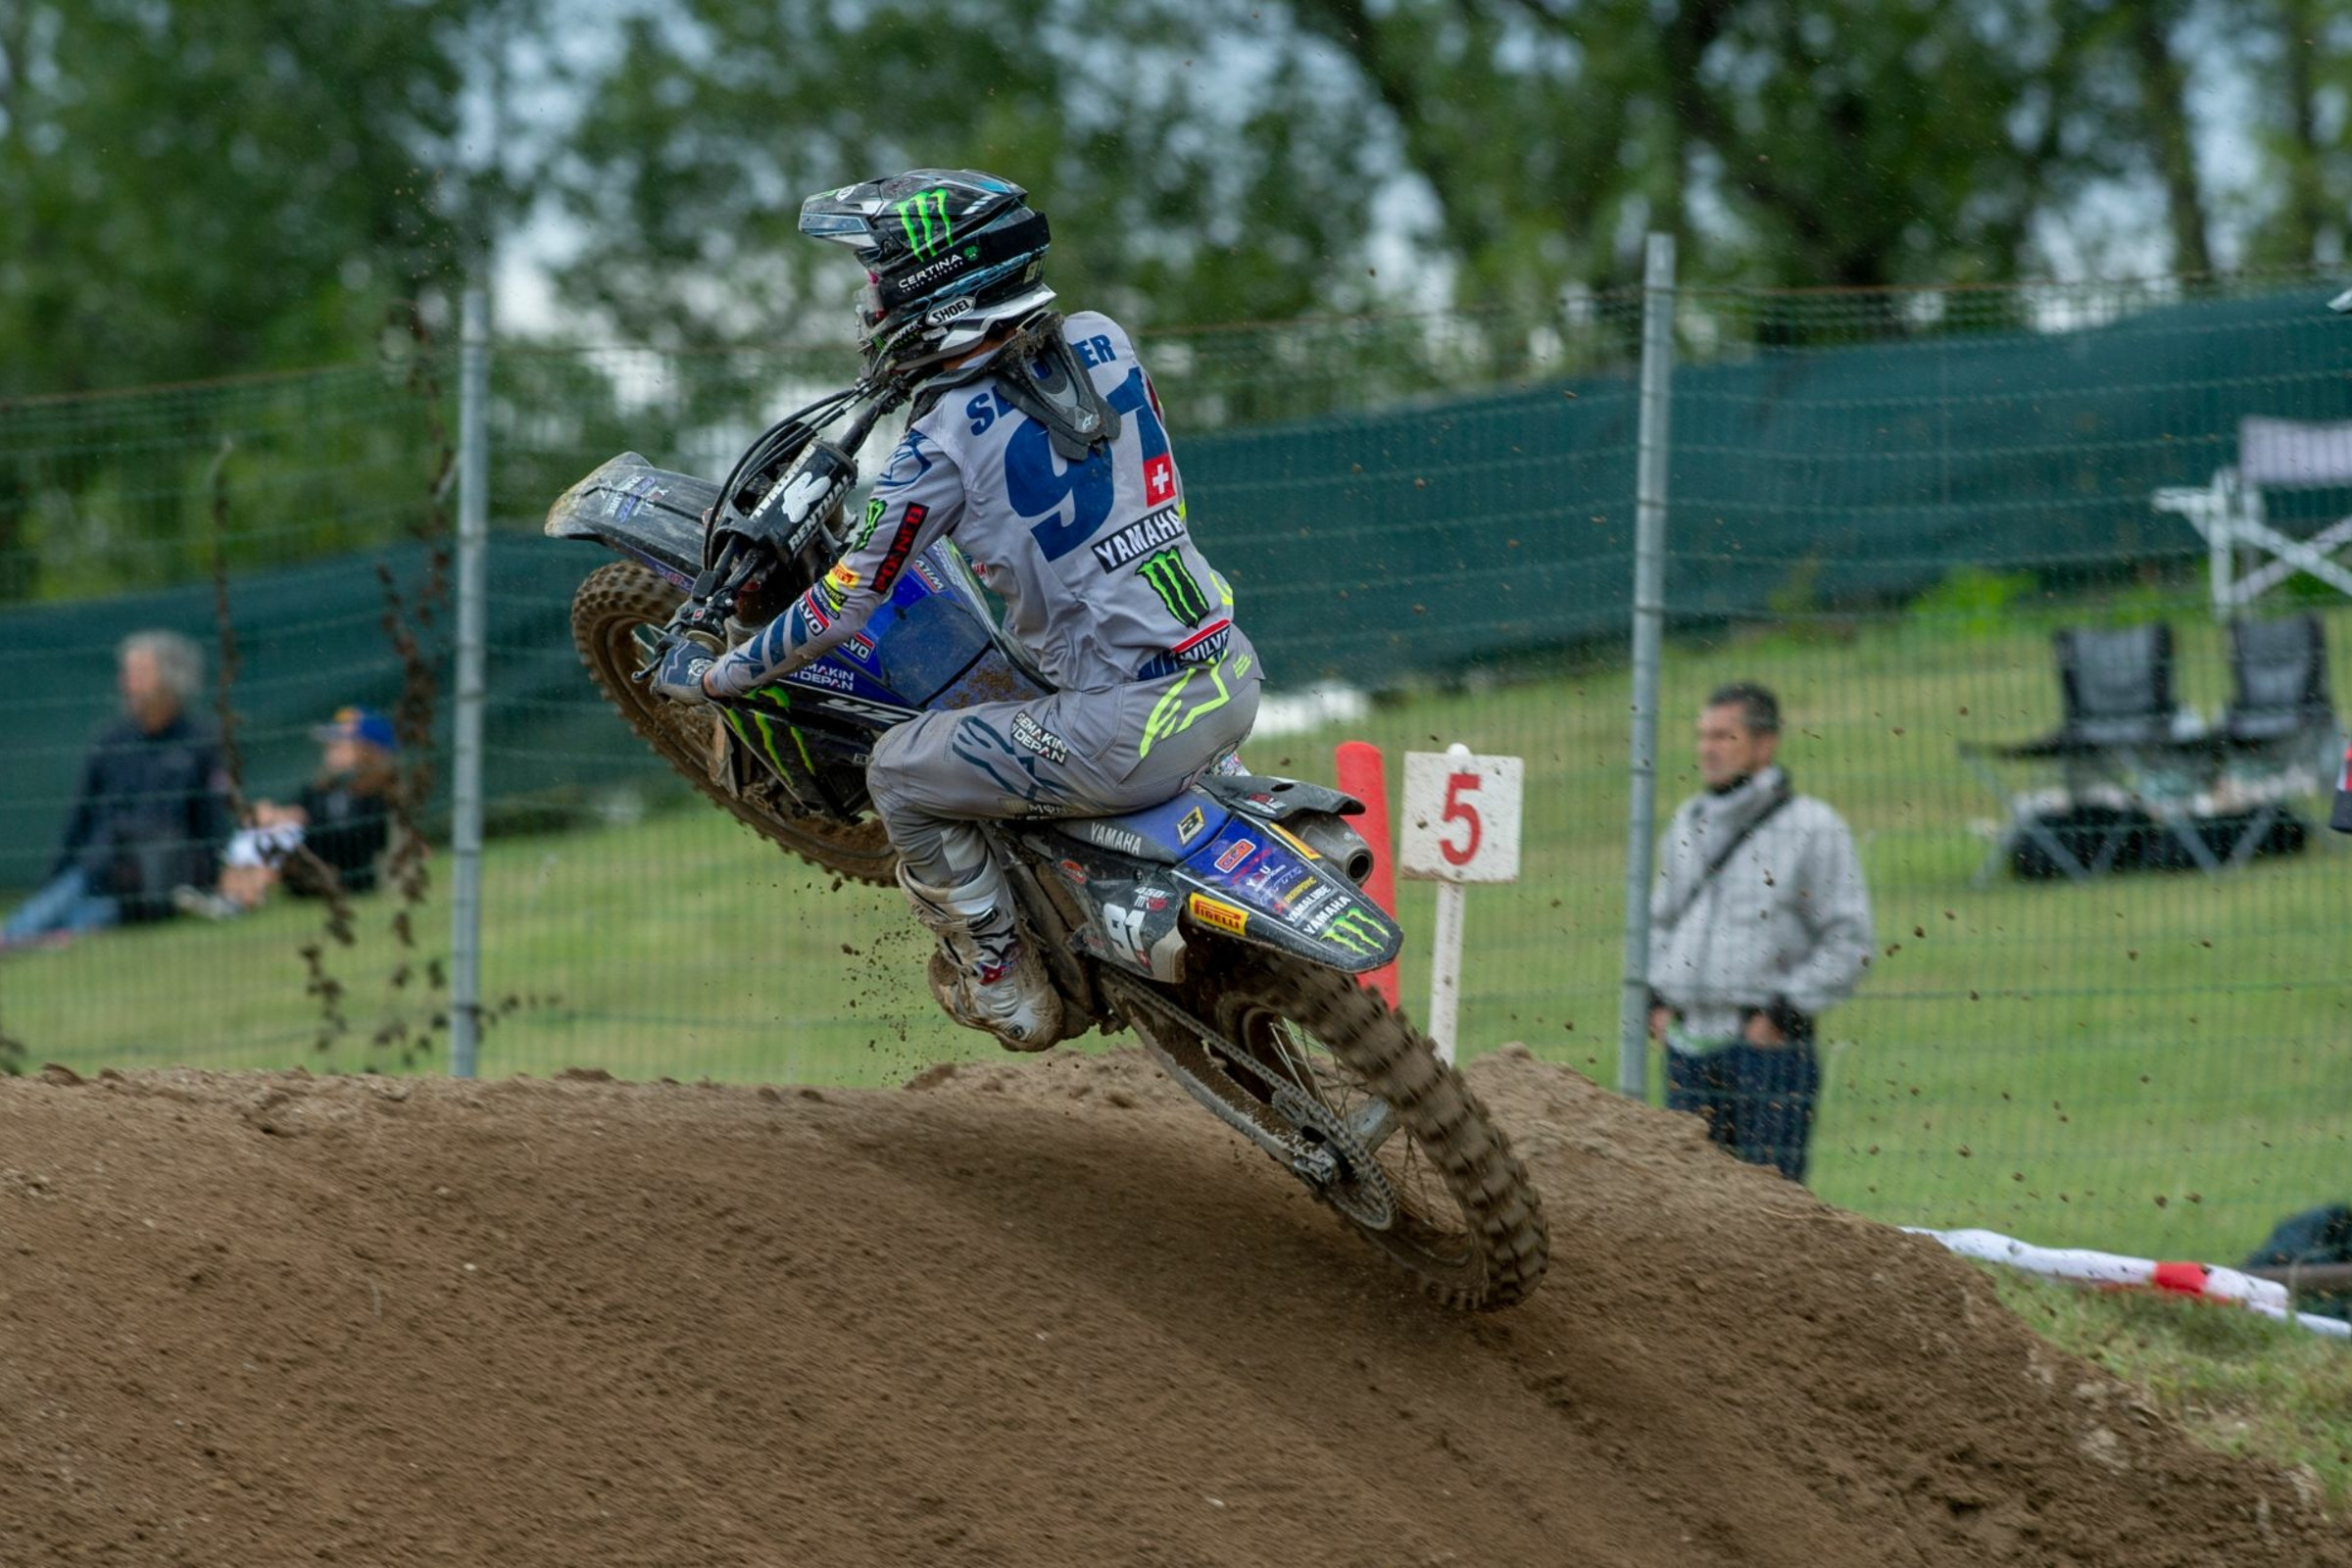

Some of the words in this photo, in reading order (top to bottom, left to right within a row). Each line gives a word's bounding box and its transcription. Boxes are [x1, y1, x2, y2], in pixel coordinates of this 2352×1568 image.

[898, 254, 963, 289] CERTINA
[932, 299, 970, 323] SHOEI
[1015, 712, 1068, 755] SEMAKIN
[1439, 772, 1482, 866] 5
[1091, 822, 1142, 856] YAMAHA
[1195, 899, 1242, 930] PIRELLI
[1285, 884, 1332, 923] YAMALUBE
[1302, 895, 1352, 935] YAMAHA
[1103, 903, 1152, 968] 91
